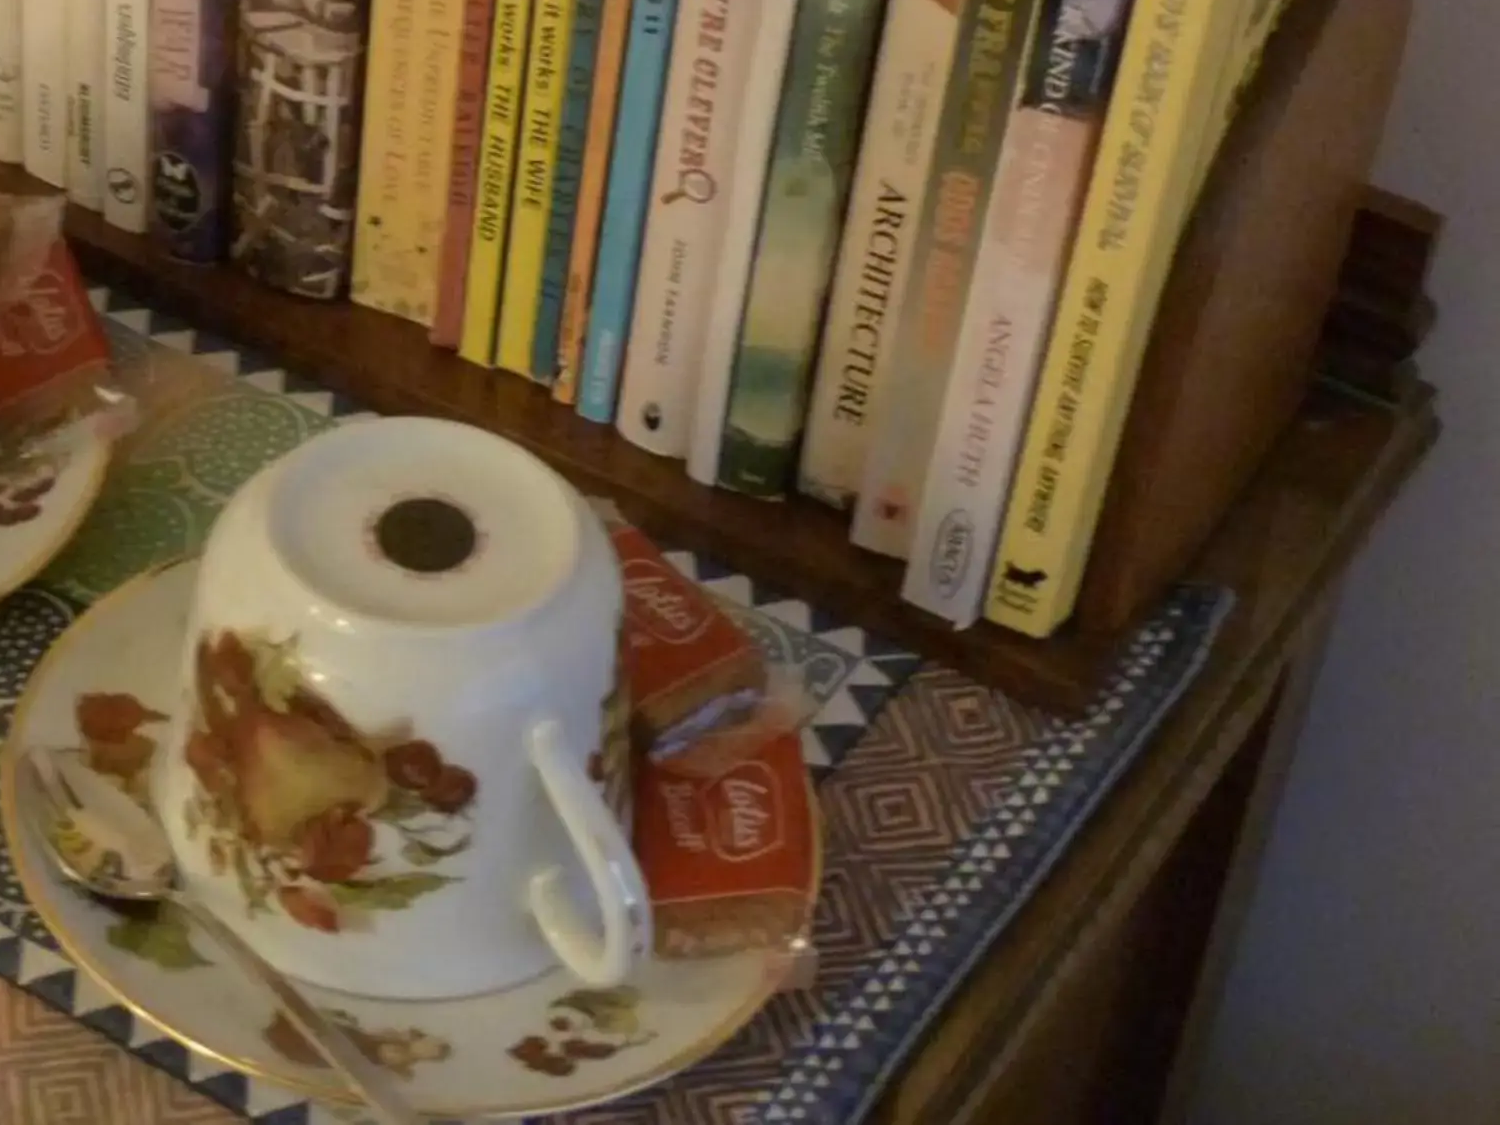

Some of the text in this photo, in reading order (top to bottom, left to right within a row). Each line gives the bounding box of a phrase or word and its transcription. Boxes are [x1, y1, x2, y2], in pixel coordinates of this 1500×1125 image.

[154, 8, 195, 84] WAR
[816, 25, 845, 57] The
[1044, 31, 1079, 99] KIND
[1139, 40, 1172, 102] BOOK
[494, 85, 512, 116] THE
[531, 110, 551, 146] THE
[1130, 102, 1155, 138] OF
[382, 149, 407, 206] LOVE
[477, 135, 506, 243] HUSBAND
[521, 158, 547, 211] WIFE
[1096, 141, 1143, 252] SURVIVAL
[831, 181, 908, 428] ARCHITECTURE
[1082, 311, 1099, 336] TO
[1086, 276, 1109, 309] HOW
[1060, 330, 1096, 397] SURVIVE
[956, 312, 1013, 488] ANGELA HUTH
[722, 778, 770, 851] Lotus
